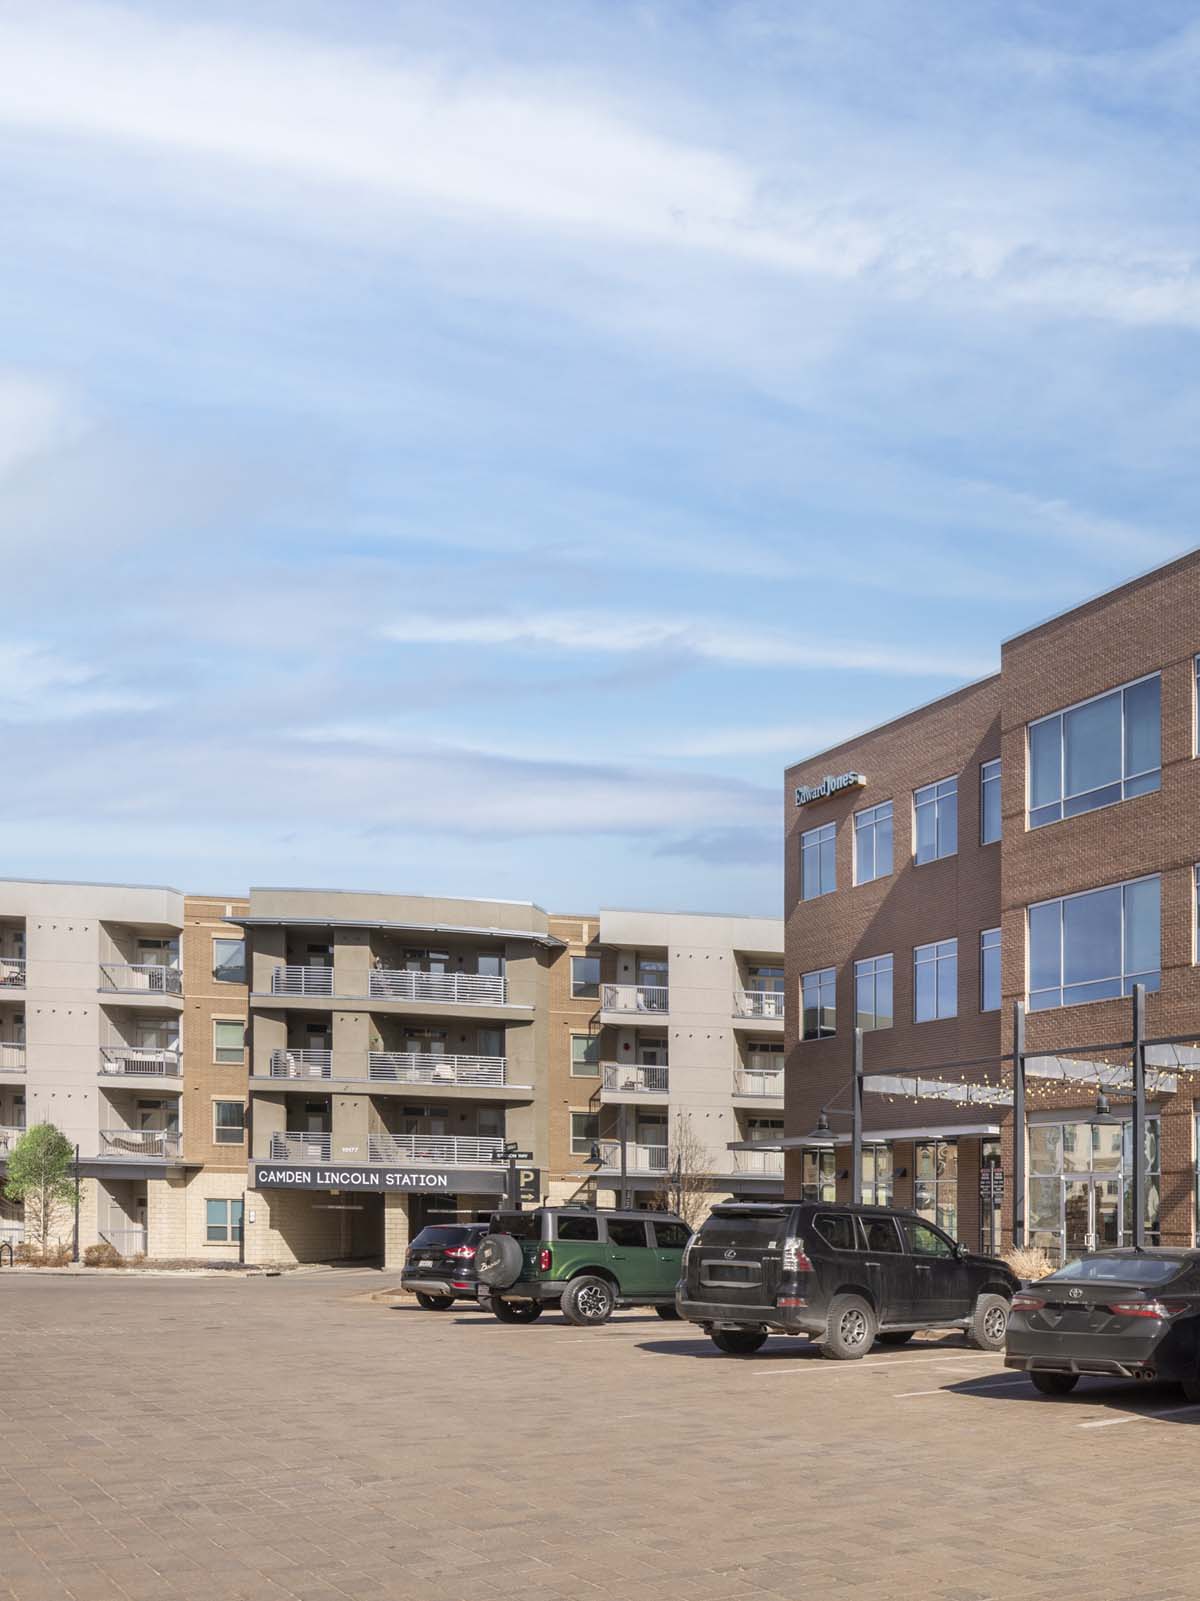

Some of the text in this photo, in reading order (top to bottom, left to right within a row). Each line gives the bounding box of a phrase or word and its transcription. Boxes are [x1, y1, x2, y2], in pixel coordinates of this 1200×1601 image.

[795, 772, 856, 806] Edward Jones
[258, 1171, 447, 1186] CAMDEN LINCOLN STATION
[520, 1171, 534, 1187] P
